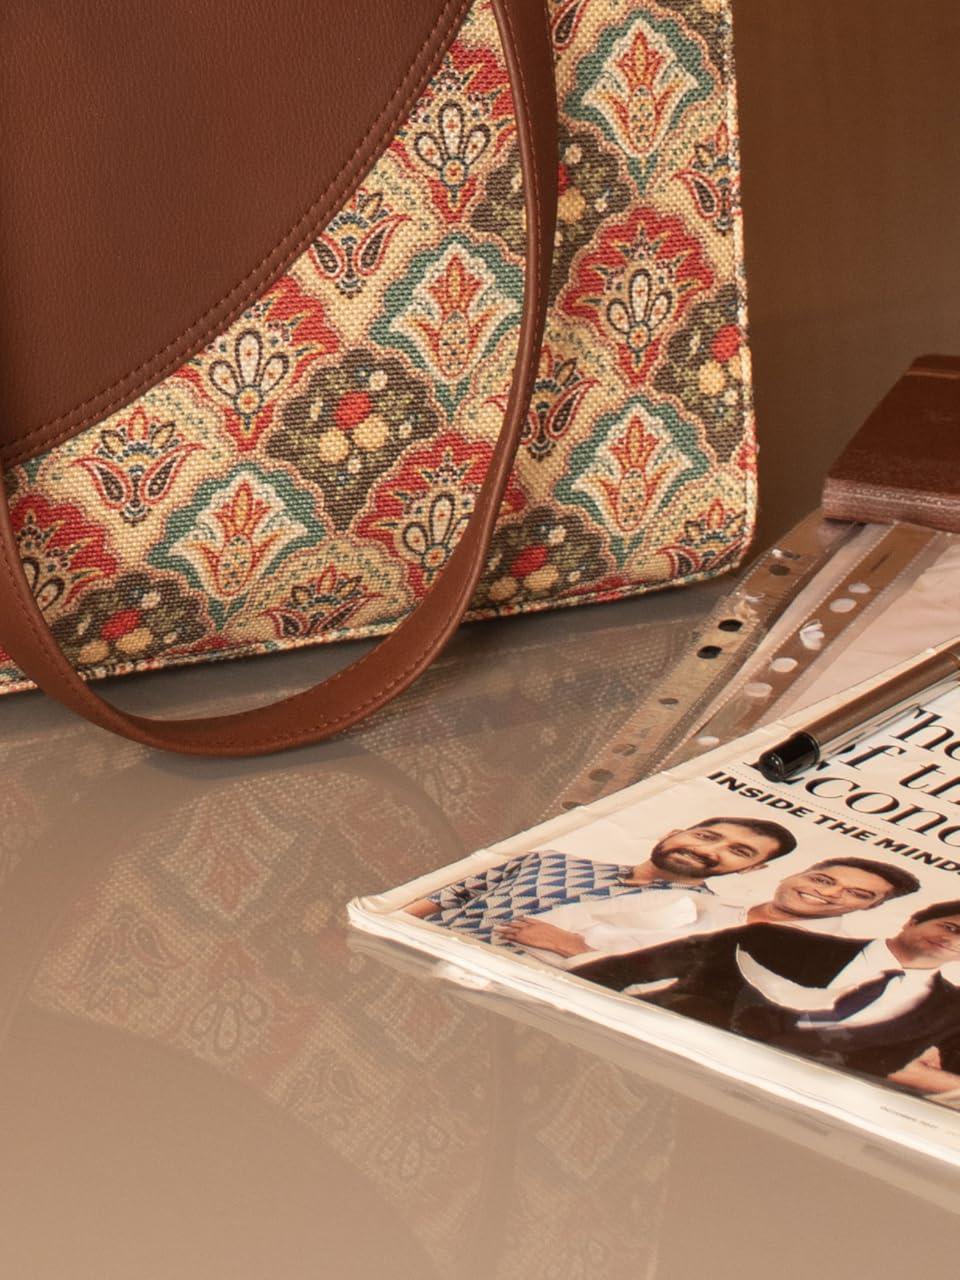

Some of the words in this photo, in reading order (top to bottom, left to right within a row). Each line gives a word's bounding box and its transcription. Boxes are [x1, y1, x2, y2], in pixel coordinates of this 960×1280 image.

[707, 771, 814, 818] INSIDE
[814, 814, 877, 841] THE
[873, 837, 960, 875] MIND
